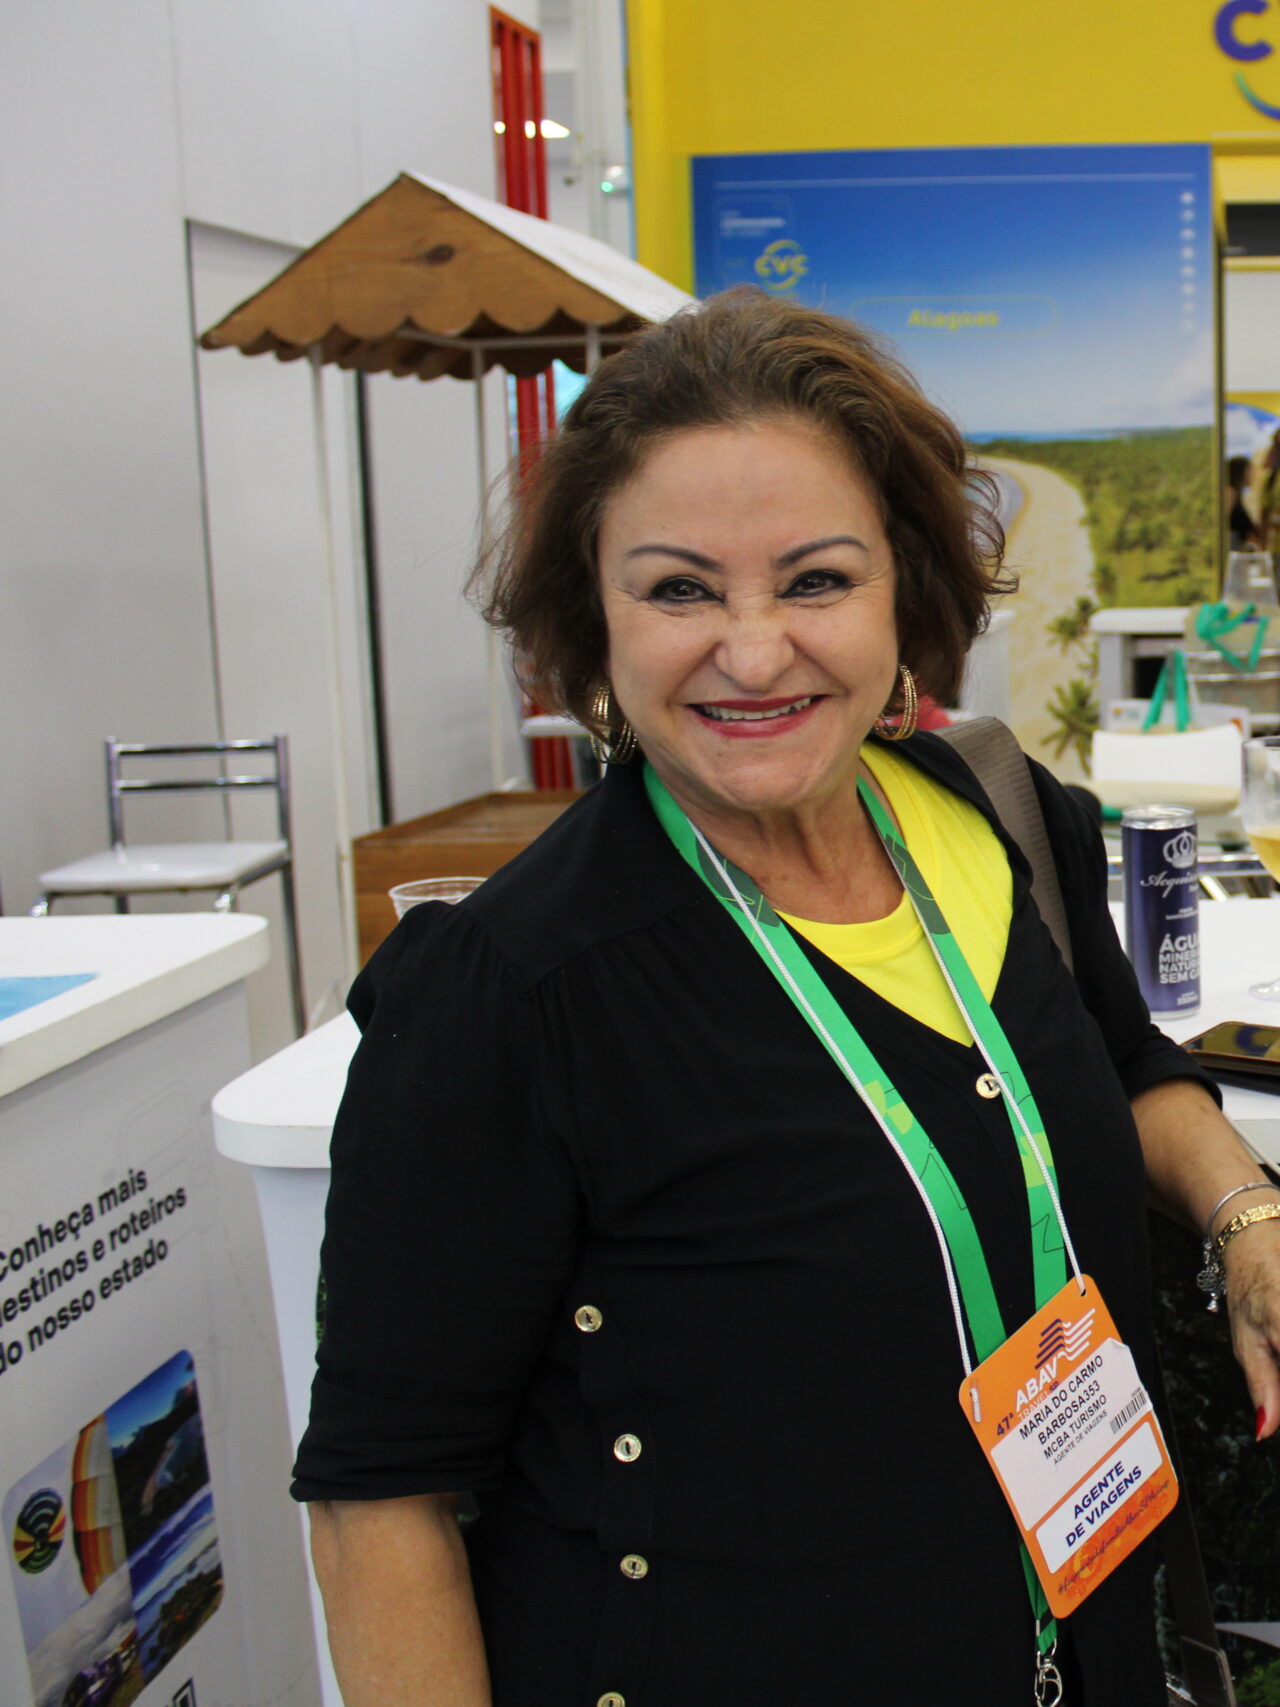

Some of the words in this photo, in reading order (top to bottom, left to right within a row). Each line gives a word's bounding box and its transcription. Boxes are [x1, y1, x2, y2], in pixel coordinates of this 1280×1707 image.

[1159, 933, 1199, 953] ÁGU
[1160, 972, 1189, 984] SEM
[98, 1169, 147, 1216] mais
[0, 1250, 88, 1329] estinos
[92, 1239, 105, 1261] e
[109, 1187, 187, 1251] roteiros
[27, 1289, 96, 1352] nosso
[99, 1239, 168, 1300] estado
[1015, 1355, 1058, 1412] ABAV
[1019, 1403, 1054, 1440] MARIA
[1051, 1389, 1068, 1409] DO
[1067, 1355, 1104, 1393] CARMO
[1038, 1379, 1101, 1446] BARBOSA353
[1043, 1431, 1071, 1460] MCBA
[1069, 1394, 1108, 1434] TURISMO
[1053, 1441, 1076, 1465] AGENTE
[1075, 1432, 1085, 1443] DE
[1083, 1410, 1108, 1436] VIAGENS
[1065, 1522, 1086, 1548] DE
[1085, 1465, 1142, 1526] VIAGENS
[1073, 1461, 1125, 1519] AGENTE
